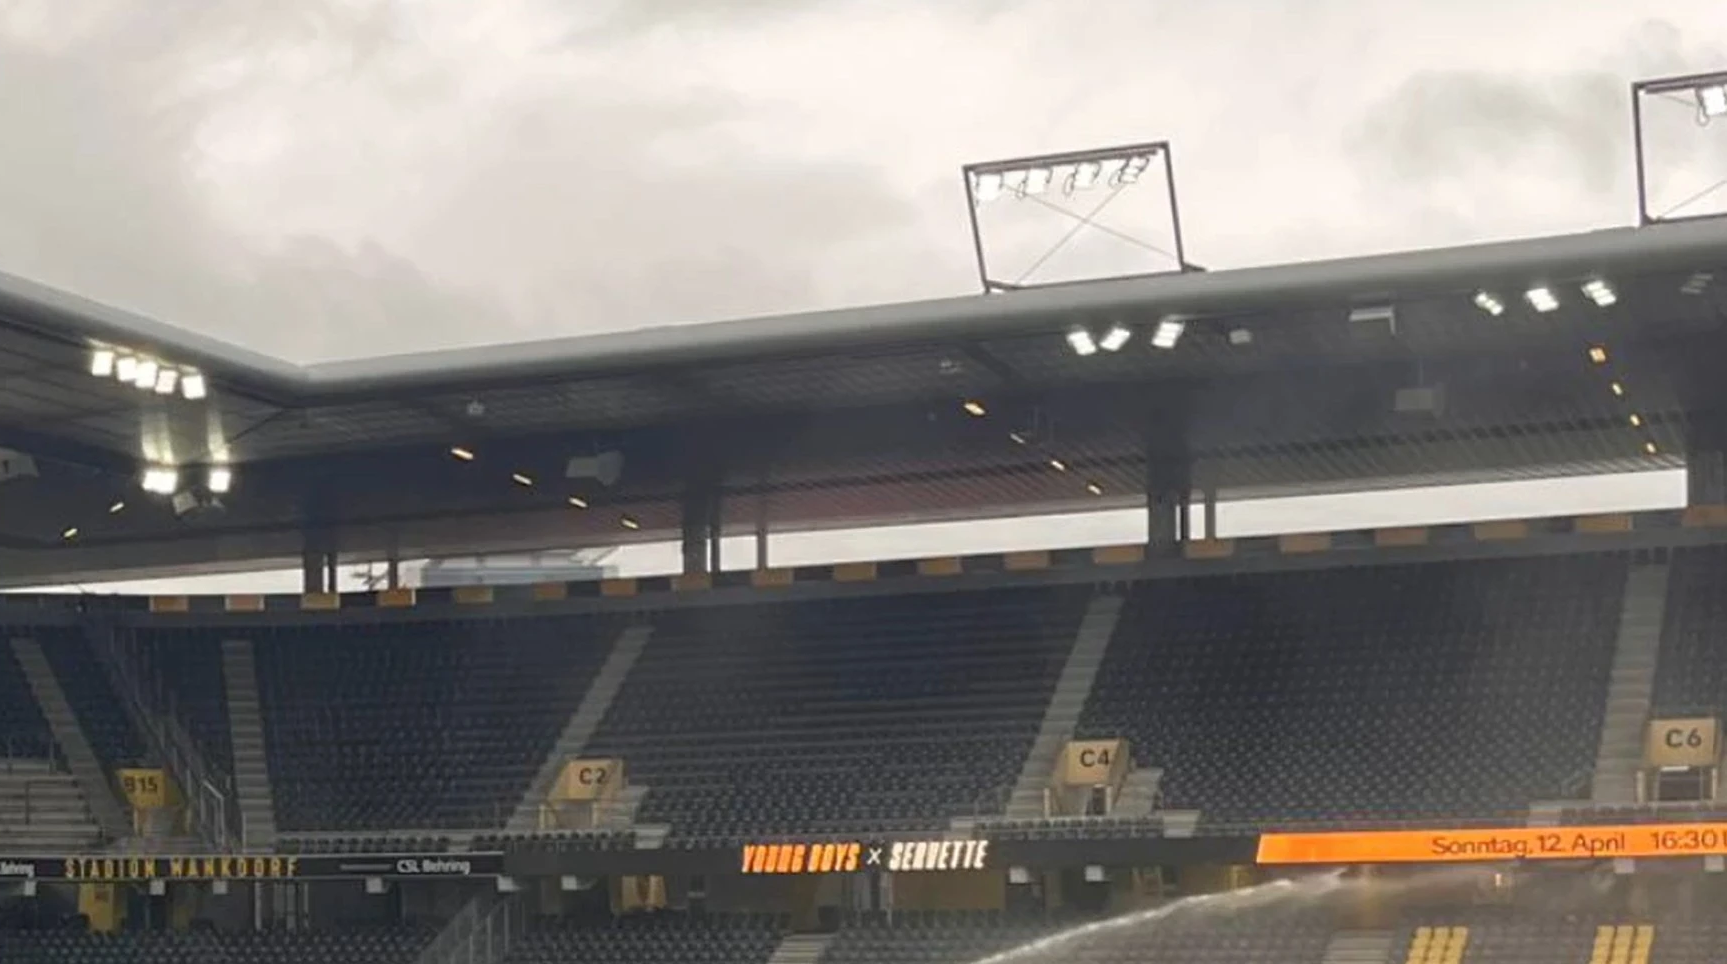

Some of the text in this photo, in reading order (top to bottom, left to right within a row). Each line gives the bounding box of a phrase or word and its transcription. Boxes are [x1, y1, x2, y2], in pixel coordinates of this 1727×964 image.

[1665, 728, 1702, 748] C6
[1080, 749, 1109, 768] C4
[579, 767, 607, 785] C2
[1570, 832, 1625, 858] April
[1650, 829, 1718, 851] 16:30
[63, 855, 299, 879] STADION WANKDORF
[741, 844, 806, 873] YOUNG
[807, 842, 861, 872] BOYS
[888, 840, 989, 871] SERVETTE
